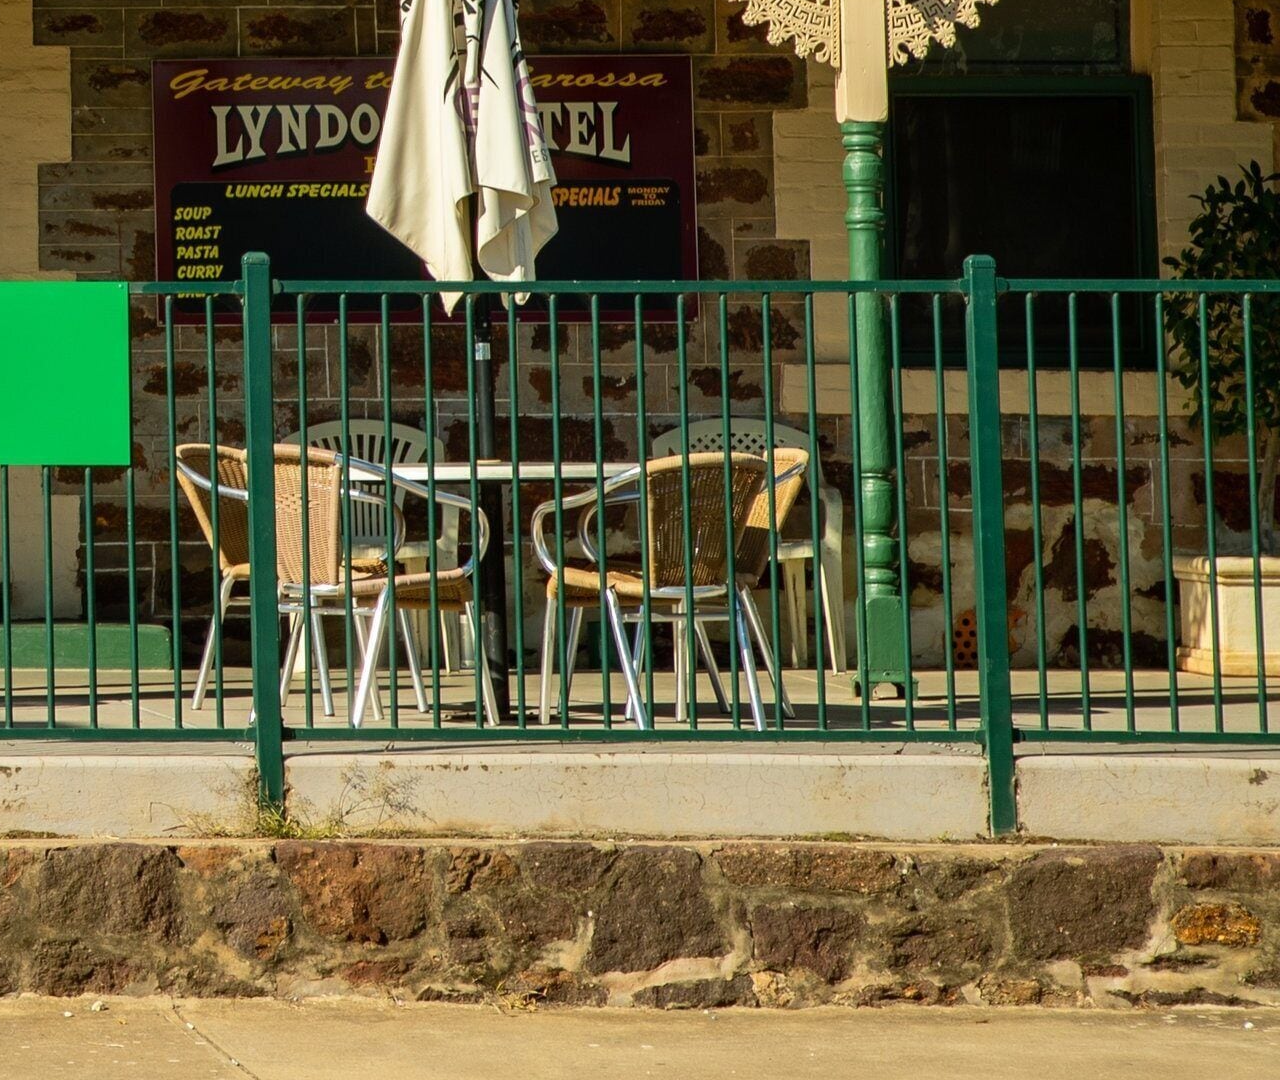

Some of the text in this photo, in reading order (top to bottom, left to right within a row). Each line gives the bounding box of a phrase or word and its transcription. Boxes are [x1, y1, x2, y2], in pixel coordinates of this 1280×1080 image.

[169, 68, 354, 100] Gateway
[530, 68, 668, 88] arossa
[210, 102, 382, 169] LYNDO
[537, 101, 631, 164] TEL
[225, 183, 370, 198] LUNCH SPECIALS
[627, 186, 670, 194] MONDAY
[174, 207, 212, 221] SOUP
[175, 225, 222, 240] ROAST
[176, 245, 220, 259] PASTA
[177, 265, 224, 280] CURRY
